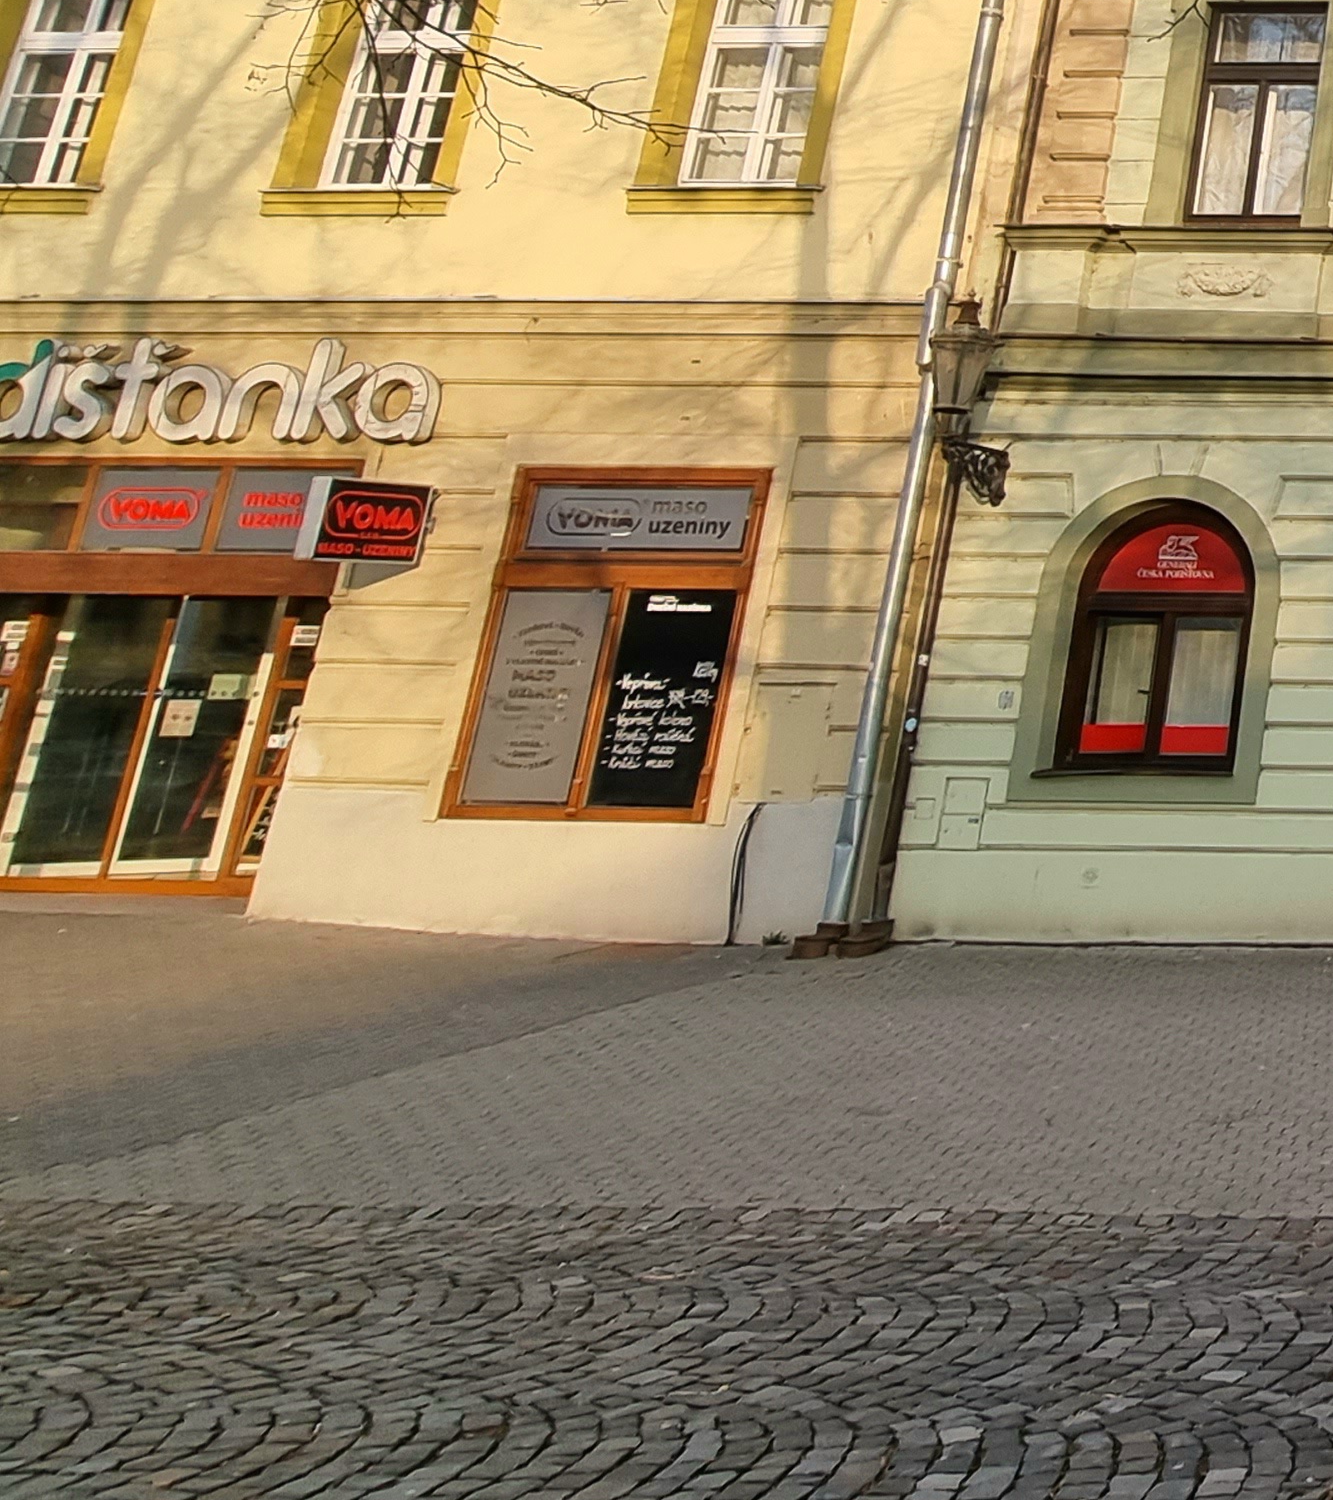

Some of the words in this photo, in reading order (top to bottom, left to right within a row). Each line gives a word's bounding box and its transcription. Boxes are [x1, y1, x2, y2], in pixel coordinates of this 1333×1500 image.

[107, 495, 191, 522] VOMA
[242, 491, 305, 508] maso
[652, 500, 708, 516] maso
[238, 509, 307, 530] uzeni
[335, 499, 415, 531] VOMA
[648, 517, 732, 540] uzeniny
[317, 542, 354, 555] MASO
[362, 543, 417, 557] UZENINY
